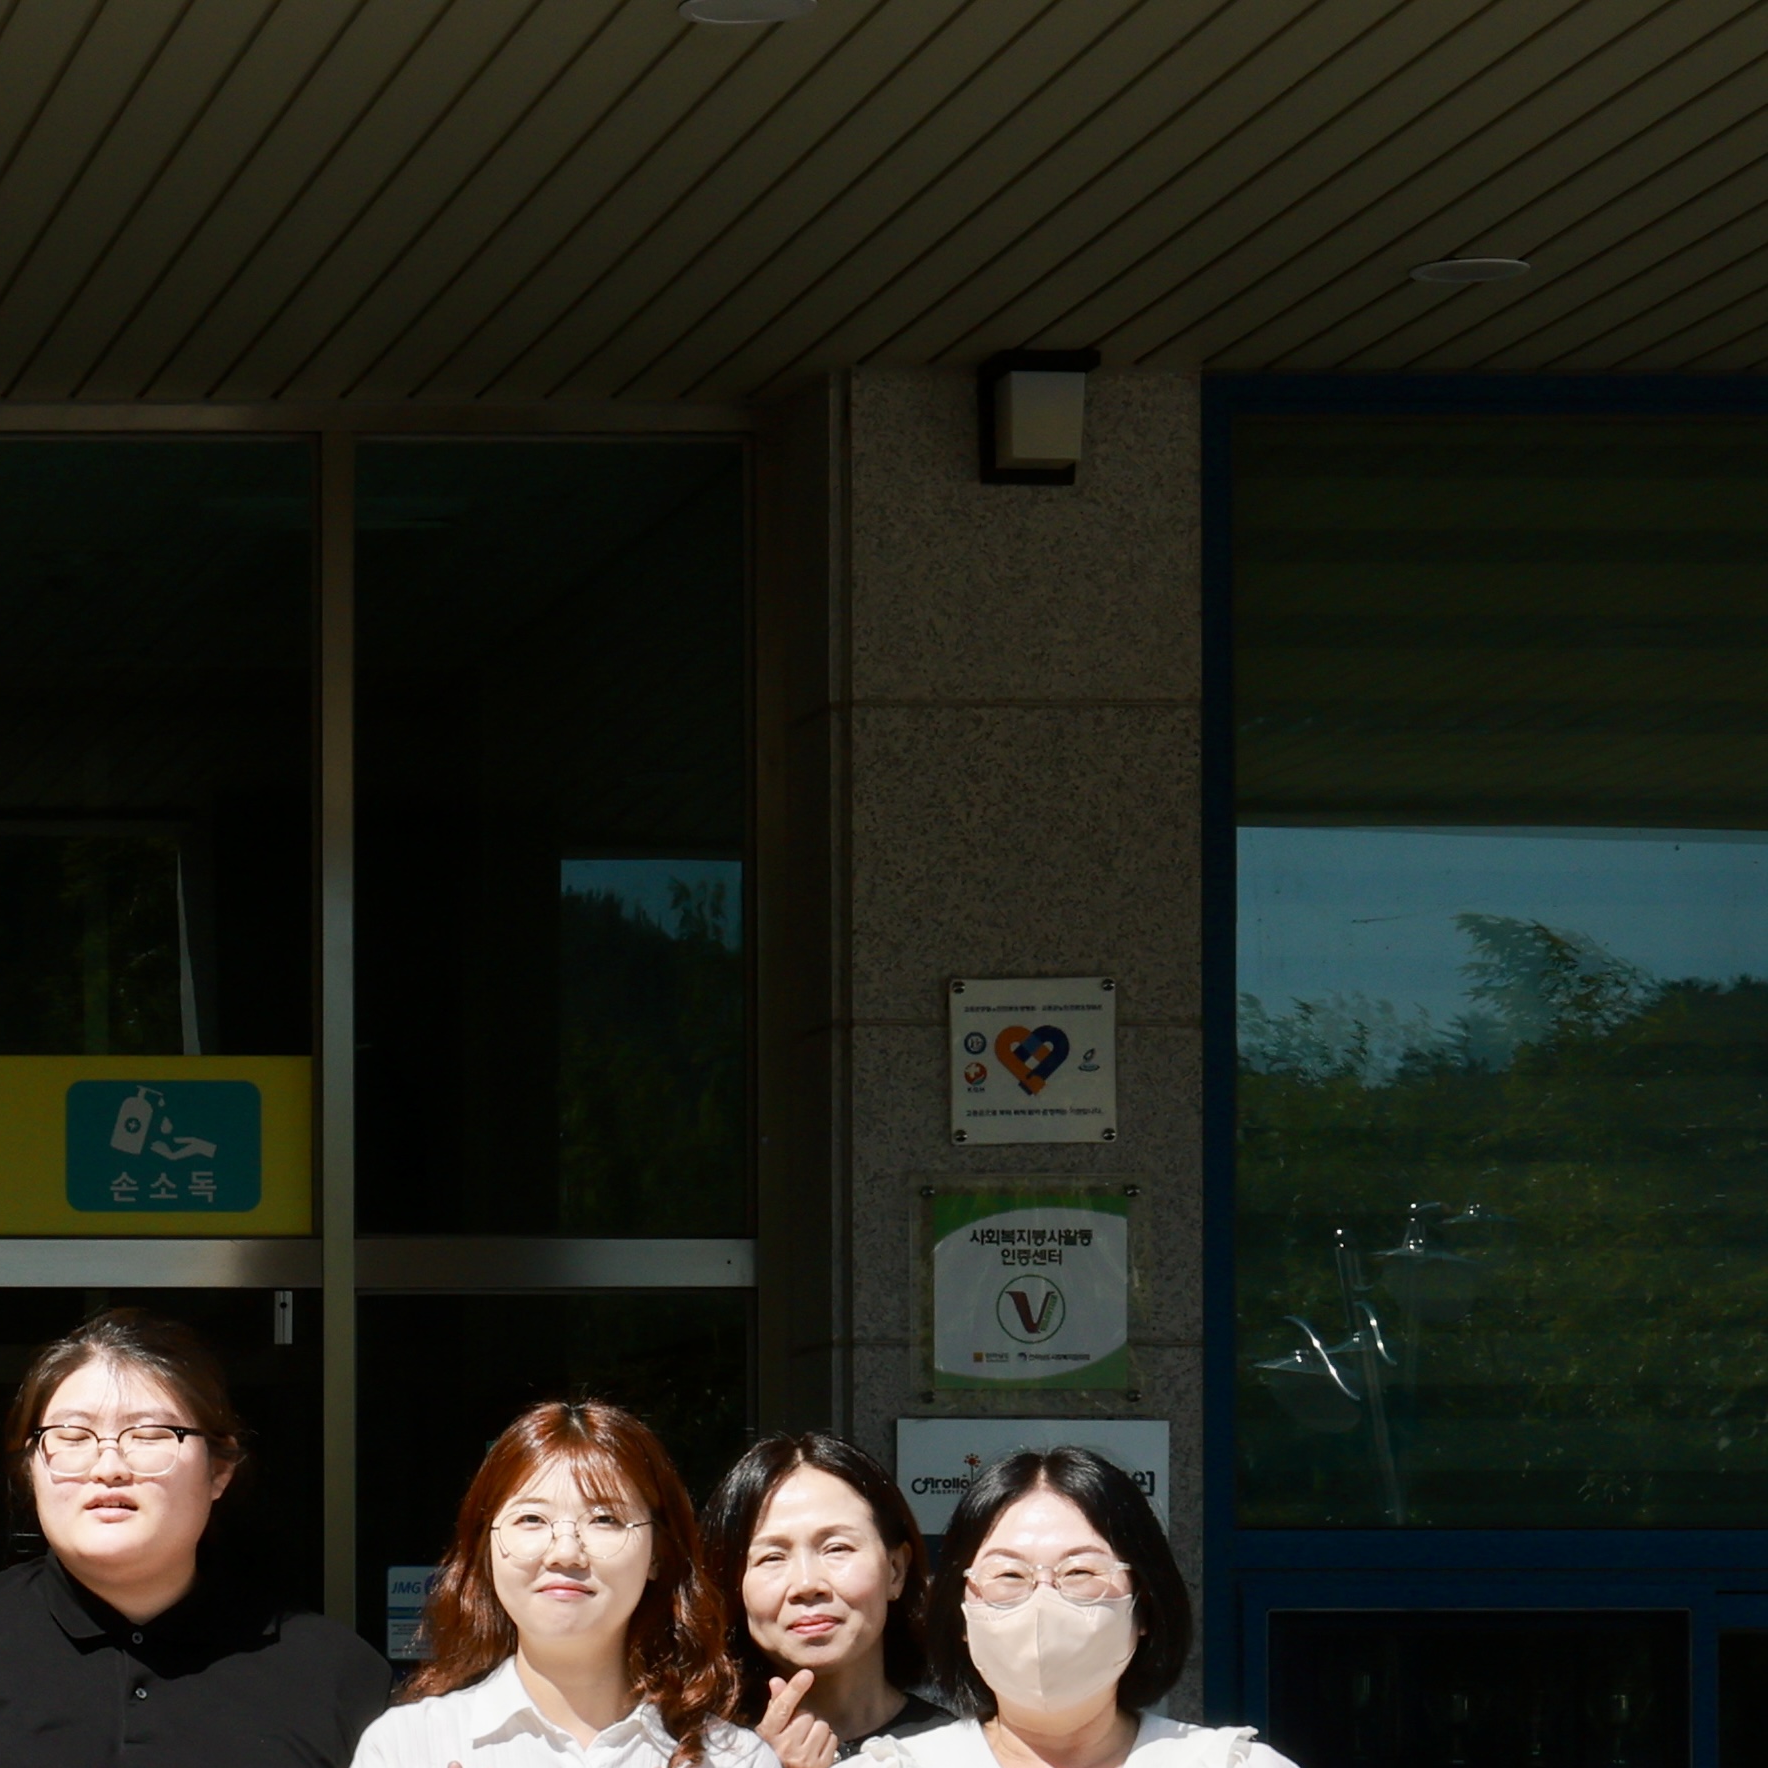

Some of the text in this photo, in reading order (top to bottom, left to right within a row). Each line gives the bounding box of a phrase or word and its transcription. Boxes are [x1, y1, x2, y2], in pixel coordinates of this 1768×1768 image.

[970, 1229, 1093, 1246] 사회복지봉사활동
[1001, 1249, 1062, 1265] 인증센터
[392, 1582, 421, 1594] JMG
